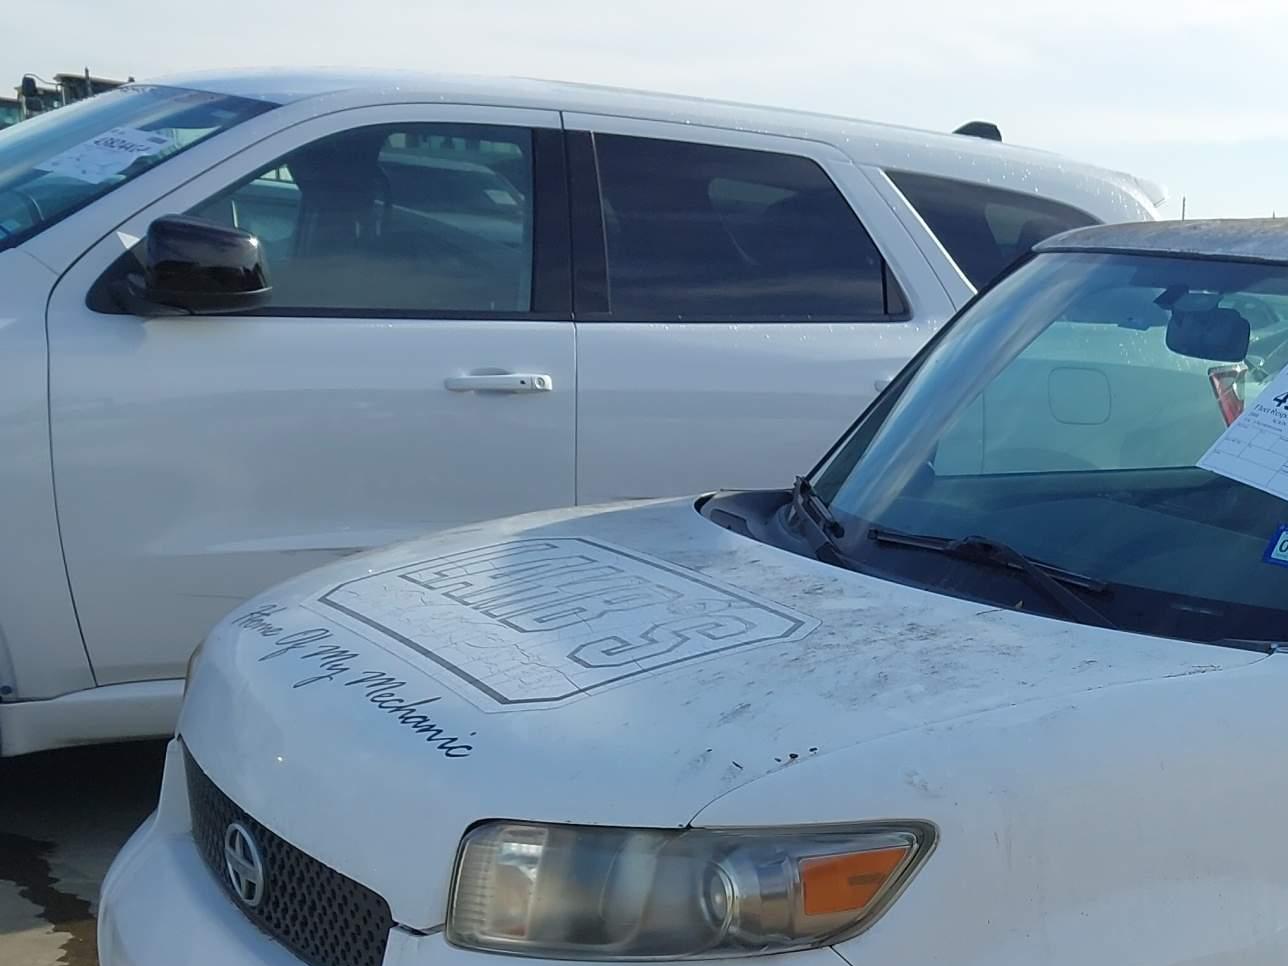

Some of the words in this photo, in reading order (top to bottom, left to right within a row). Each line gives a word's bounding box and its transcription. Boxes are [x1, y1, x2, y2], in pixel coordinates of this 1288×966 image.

[231, 603, 287, 637] Home
[292, 644, 360, 689] My
[344, 670, 477, 758] Mechanic
